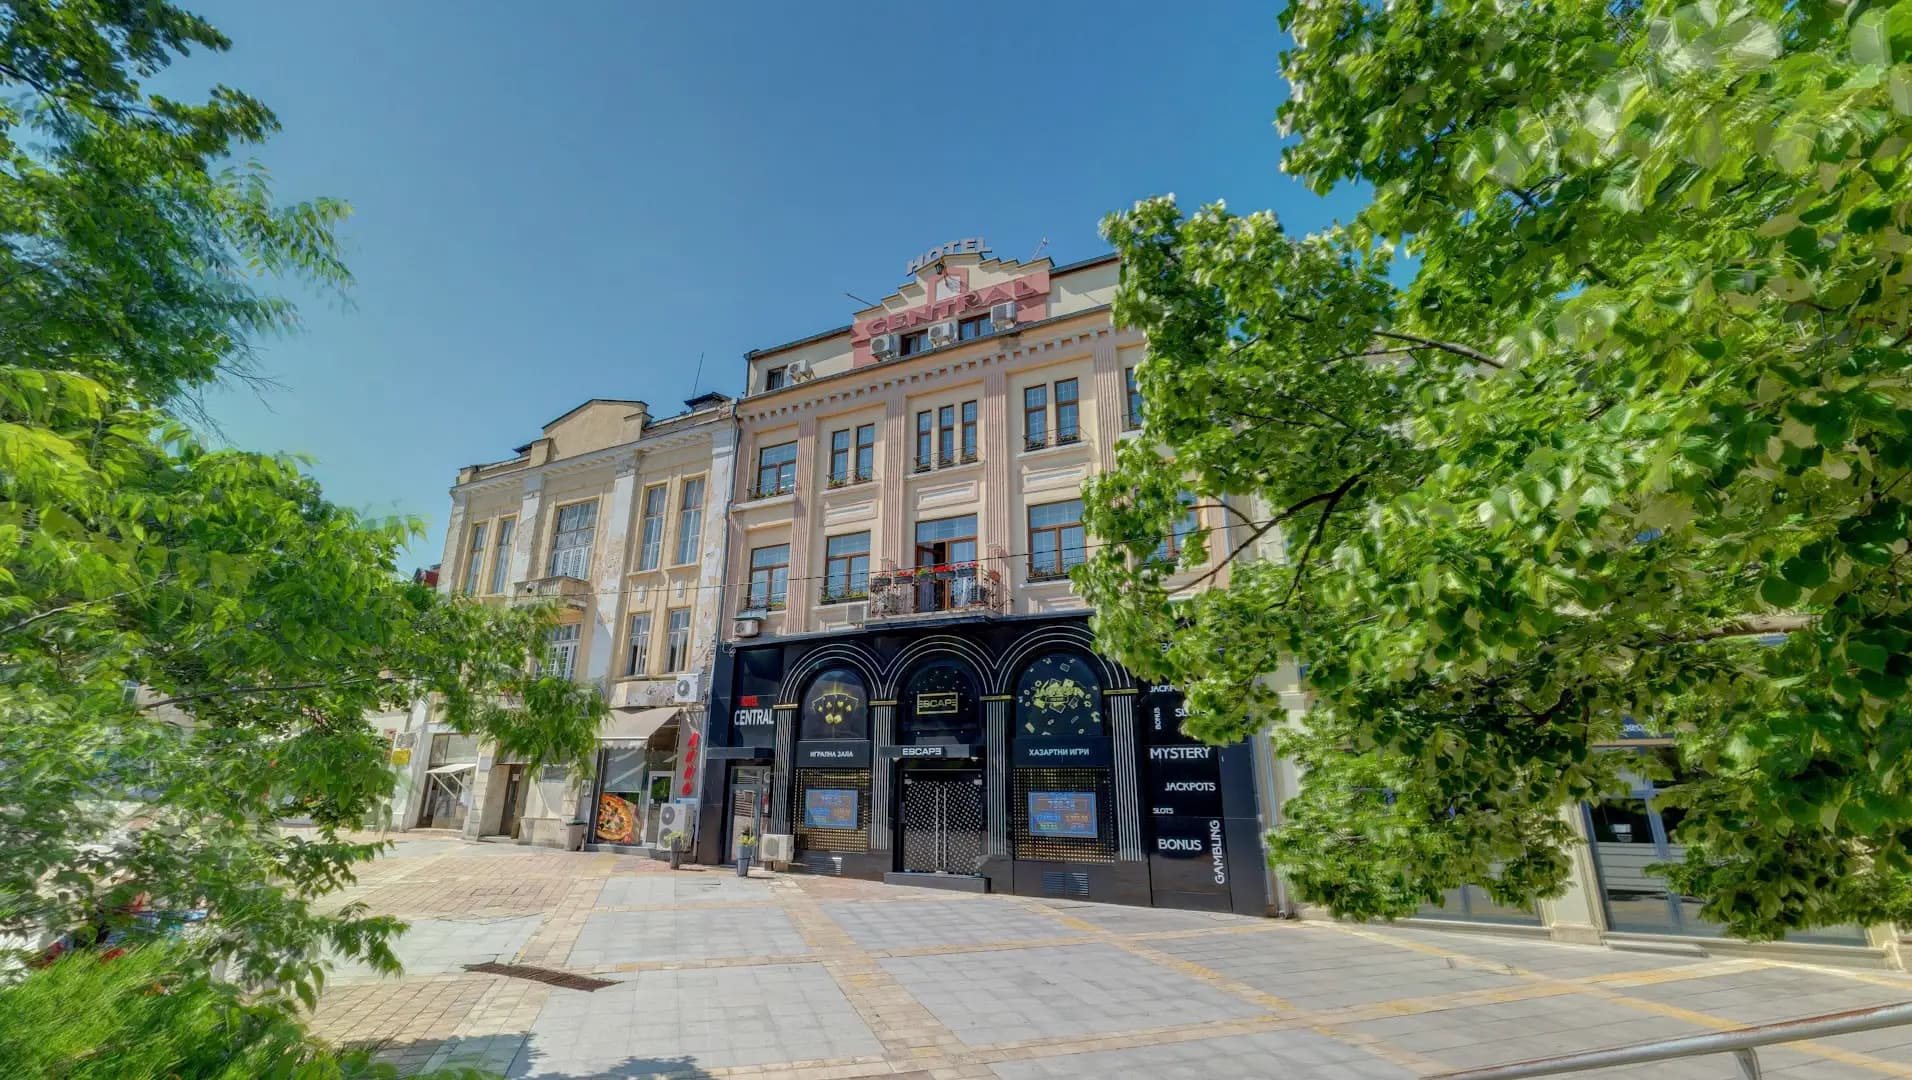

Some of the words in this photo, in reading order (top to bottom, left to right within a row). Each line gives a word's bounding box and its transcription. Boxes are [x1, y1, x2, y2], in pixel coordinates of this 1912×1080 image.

[906, 237, 993, 277] HOTEL
[866, 279, 1034, 334] CENTRAL
[734, 708, 774, 725] CENTRAL
[1028, 748, 1068, 756] ХАЗАРТНИ
[1069, 748, 1090, 756] ИГРИ
[1150, 747, 1211, 760] MYSTERY
[1164, 782, 1216, 792] JACKPOTS
[1152, 807, 1174, 815] SLOTS
[1158, 838, 1202, 850] BONUS
[1209, 819, 1225, 885] GAMBLING
